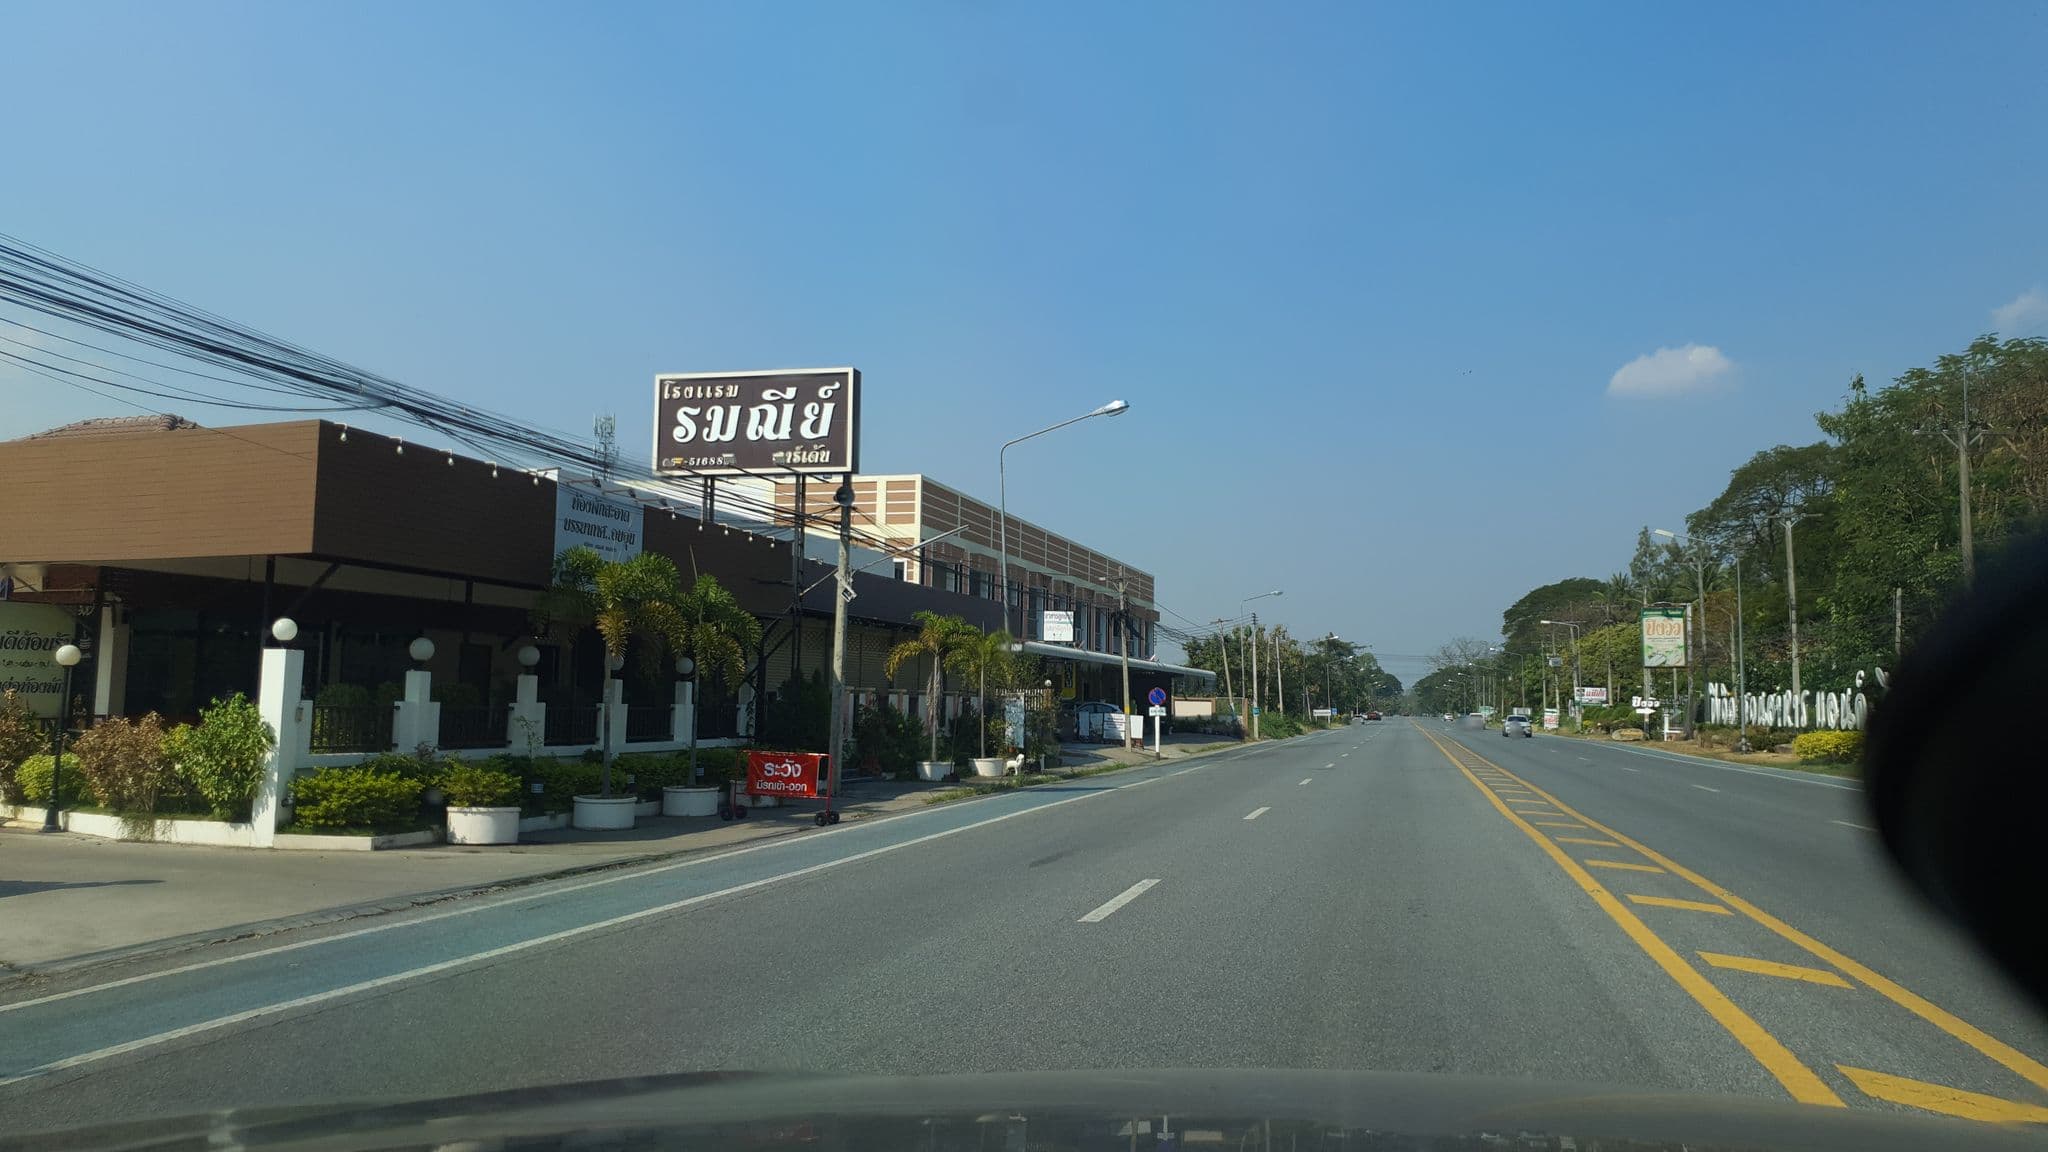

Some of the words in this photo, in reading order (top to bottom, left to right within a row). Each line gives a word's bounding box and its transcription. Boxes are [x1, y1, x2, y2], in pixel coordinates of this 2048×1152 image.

[663, 380, 739, 399] โรงแรม
[672, 382, 841, 443] รมณีย์
[764, 759, 802, 778] ระวัง
